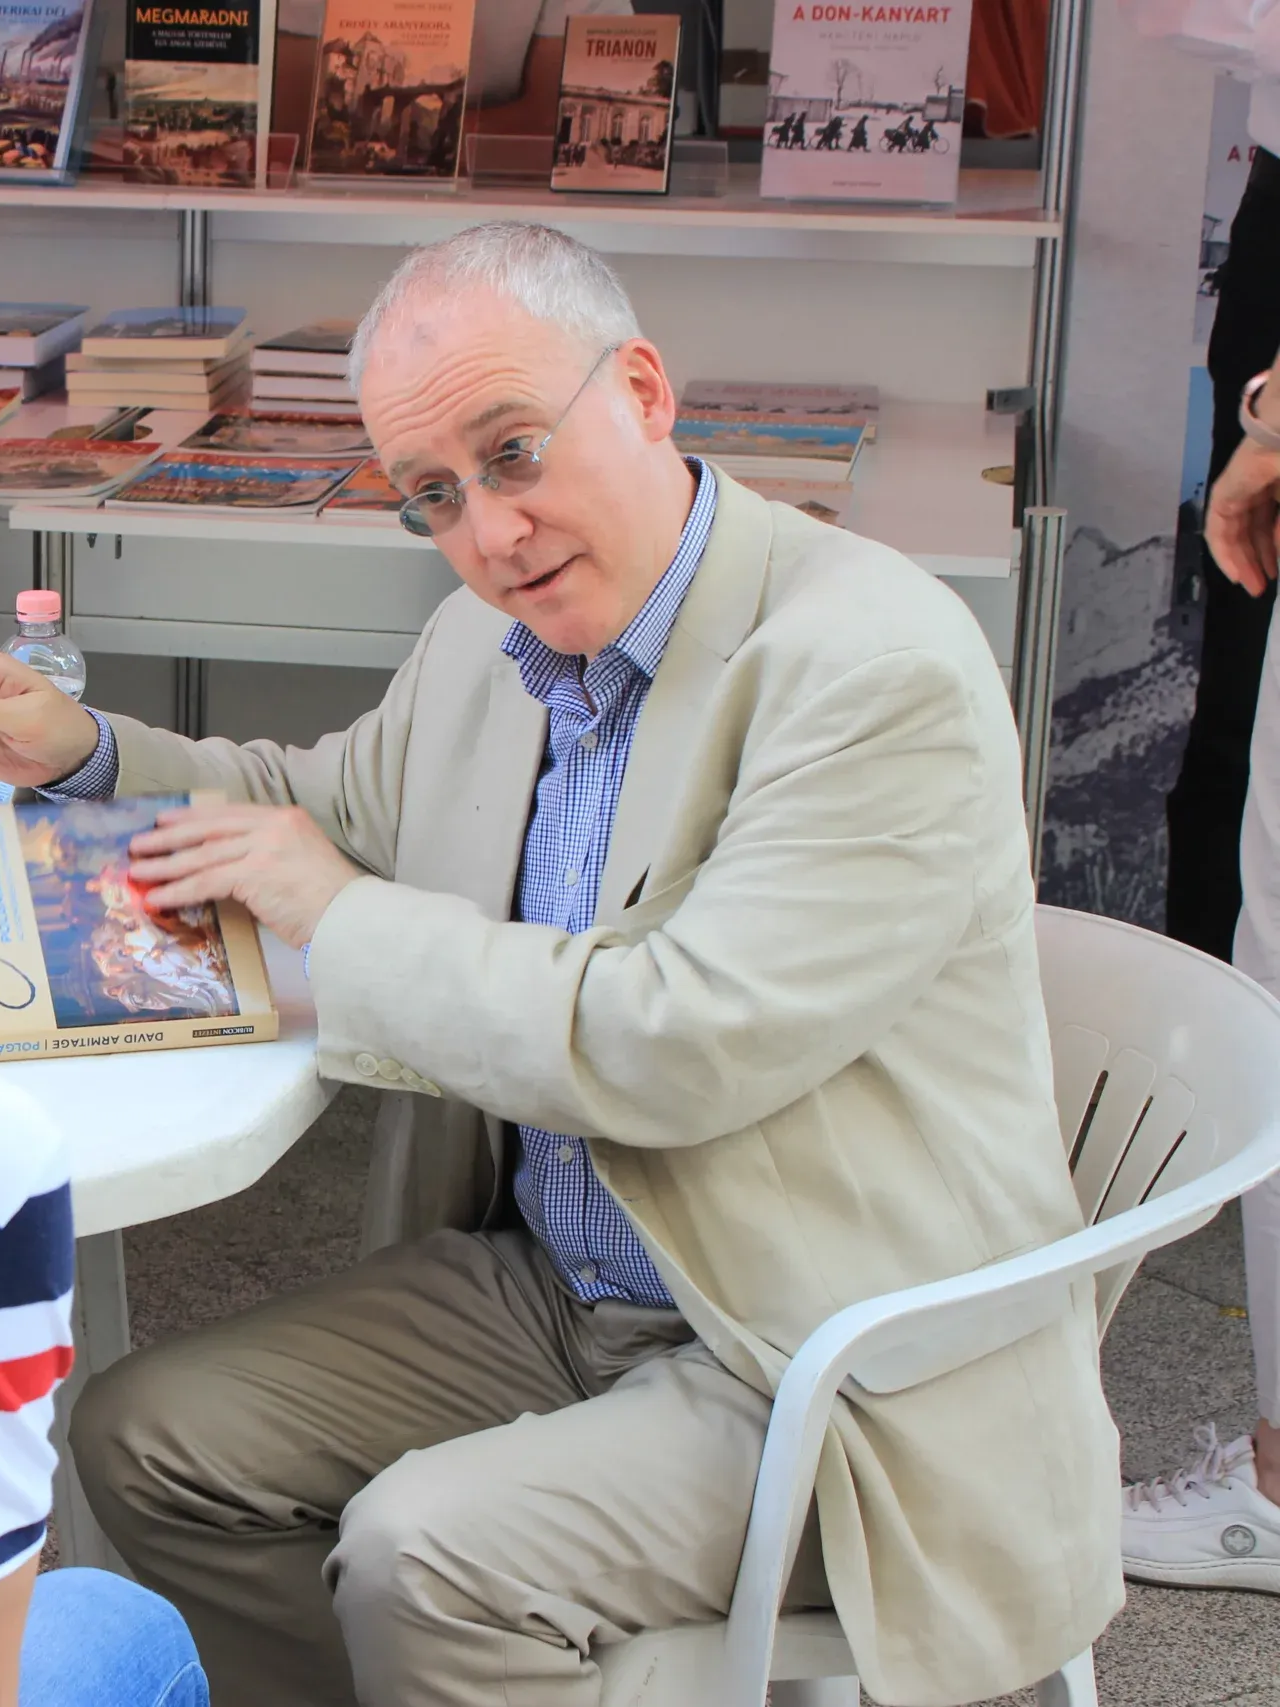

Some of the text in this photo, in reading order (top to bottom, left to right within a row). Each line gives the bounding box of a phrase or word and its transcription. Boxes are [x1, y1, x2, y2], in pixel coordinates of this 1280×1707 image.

[136, 8, 249, 26] MEGMARADNI
[793, 5, 952, 23] A DON-KANYART
[586, 39, 657, 58] TRIANON
[124, 1031, 164, 1043] DAVID
[222, 1027, 253, 1035] RUBICON
[52, 1034, 120, 1049] ARMITAGE
